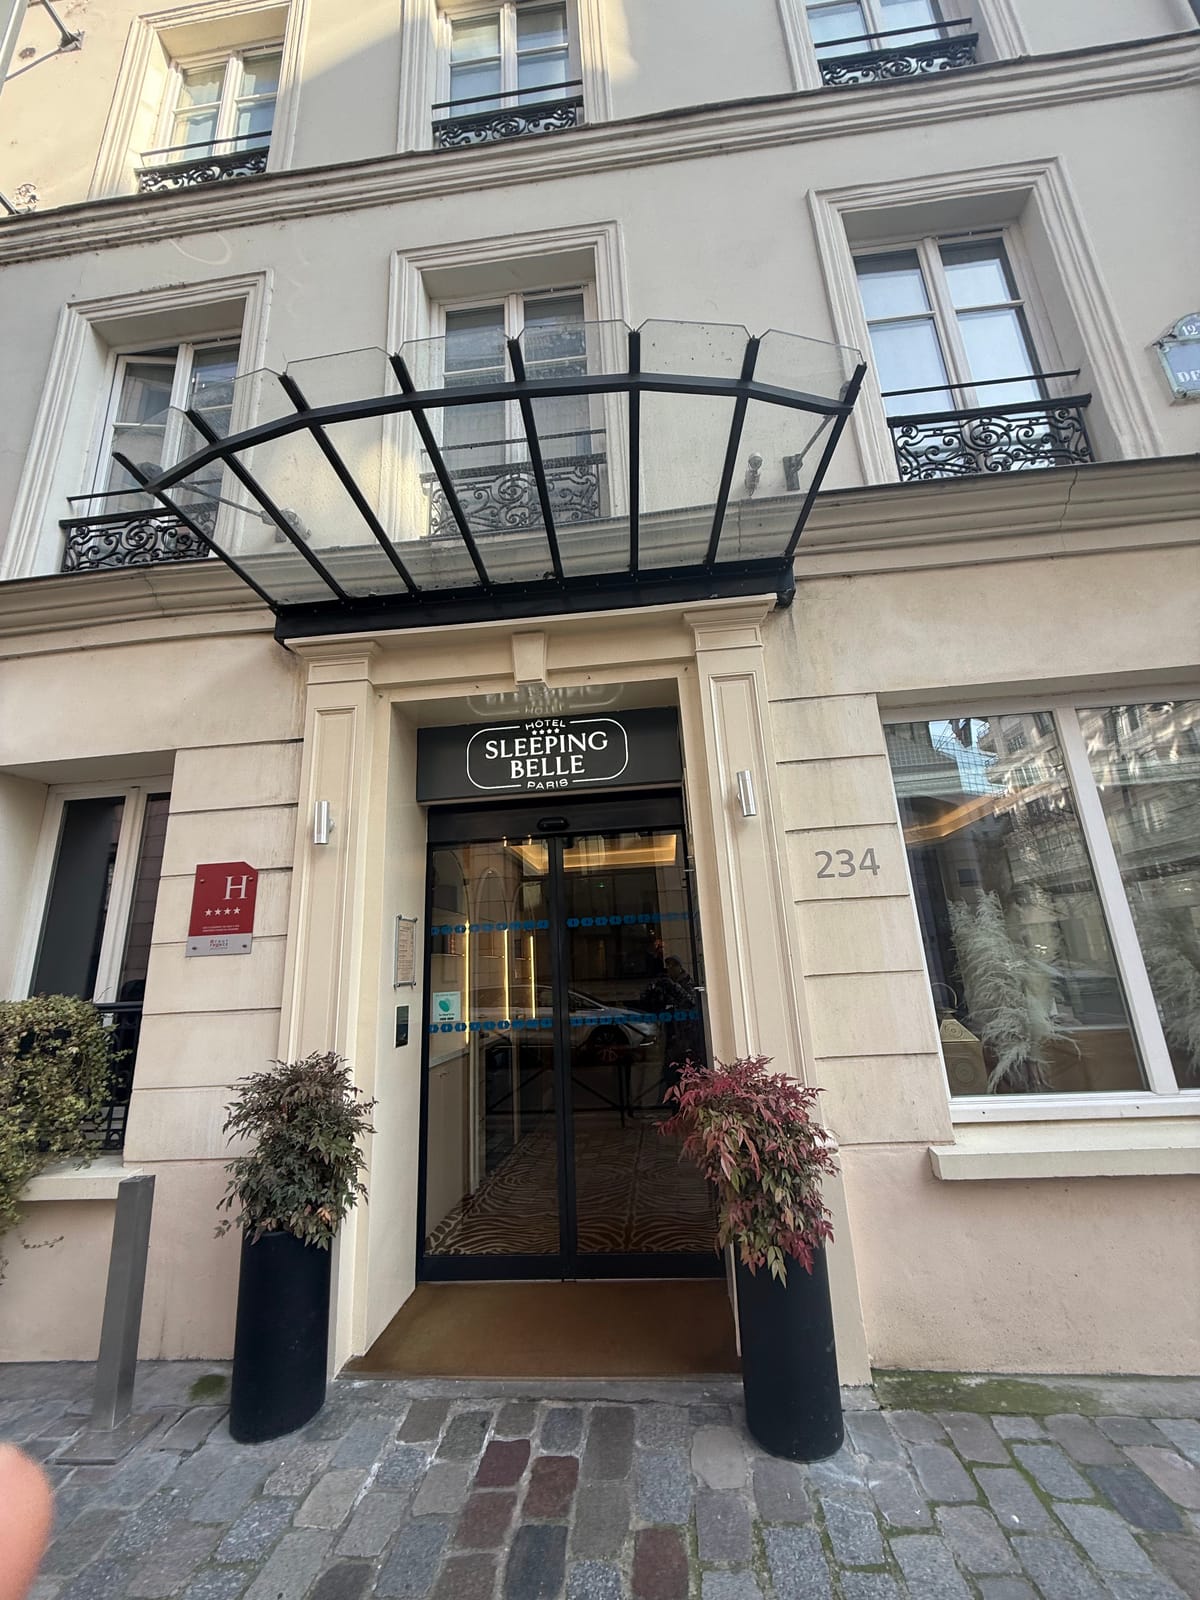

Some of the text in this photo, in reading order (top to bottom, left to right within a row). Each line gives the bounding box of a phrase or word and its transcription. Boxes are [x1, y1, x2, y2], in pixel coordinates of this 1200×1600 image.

[525, 718, 566, 731] HÔTEL
[485, 731, 608, 759] SLEEPING
[510, 754, 585, 779] BELLE
[527, 778, 568, 790] PARIS
[815, 848, 880, 878] 234
[224, 875, 248, 900] H
